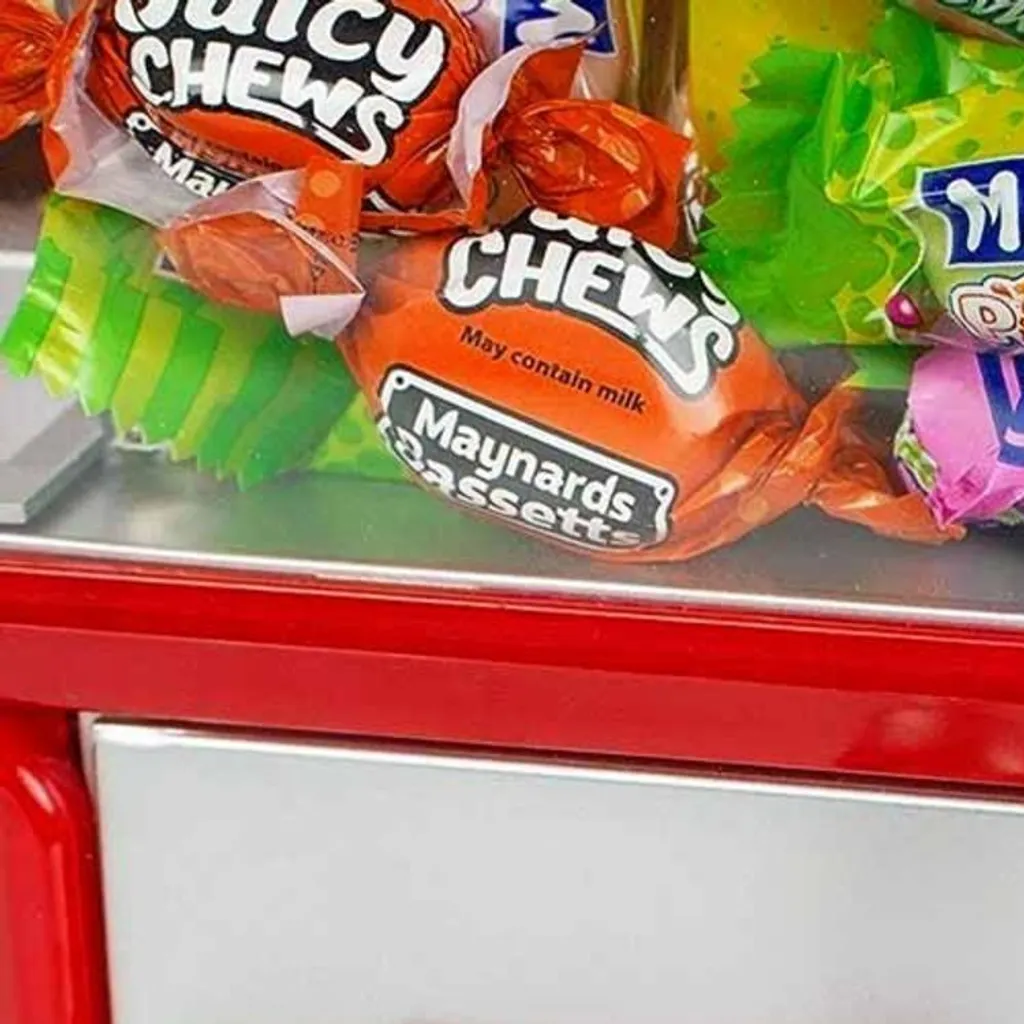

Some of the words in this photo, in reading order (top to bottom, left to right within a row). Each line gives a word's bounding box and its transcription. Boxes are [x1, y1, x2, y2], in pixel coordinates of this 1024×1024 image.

[130, 36, 404, 167] CHEWS
[443, 230, 735, 396] CHEWS
[460, 324, 508, 360] May
[511, 350, 593, 394] contain
[596, 381, 647, 414] milk
[413, 397, 637, 523] Maynards
